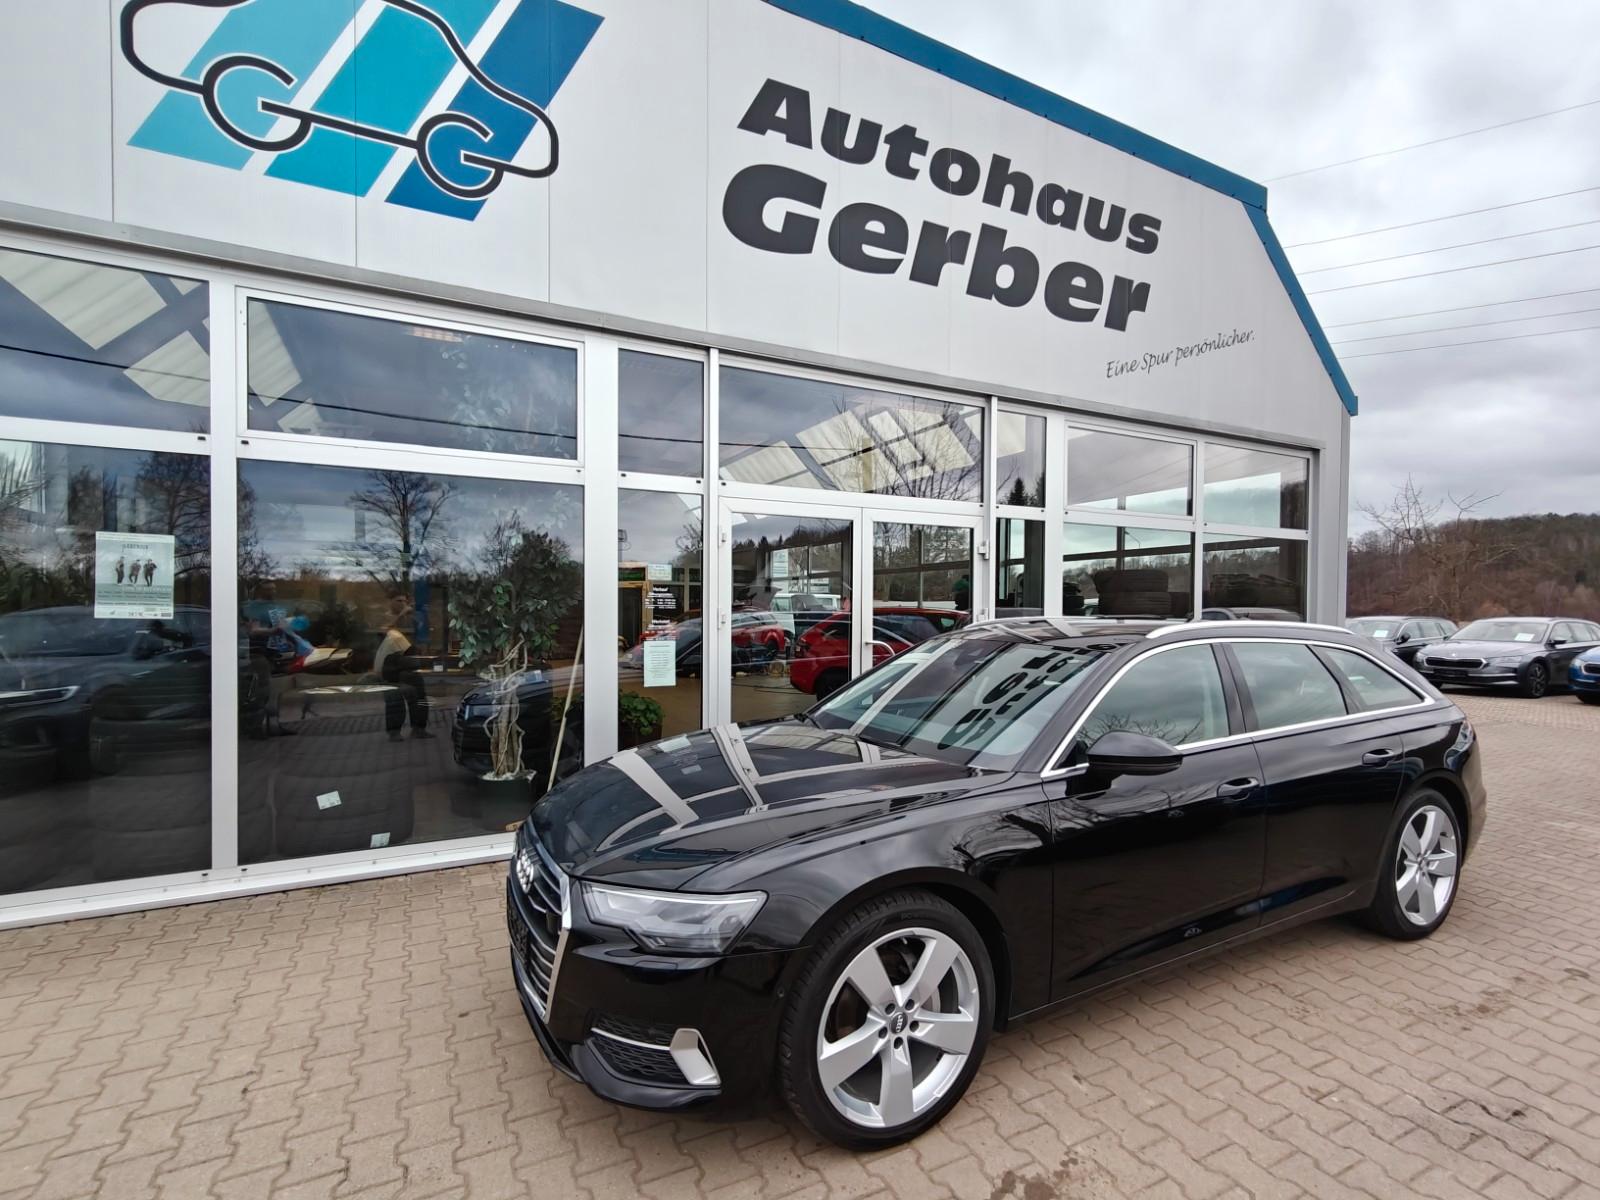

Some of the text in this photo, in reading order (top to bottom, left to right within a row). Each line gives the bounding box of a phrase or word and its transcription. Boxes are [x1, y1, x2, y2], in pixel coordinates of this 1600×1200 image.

[722, 164, 1151, 332] Gerber
[737, 78, 1162, 255] Autohaus
[1106, 328, 1255, 378] Eine Spur persönlicher.
